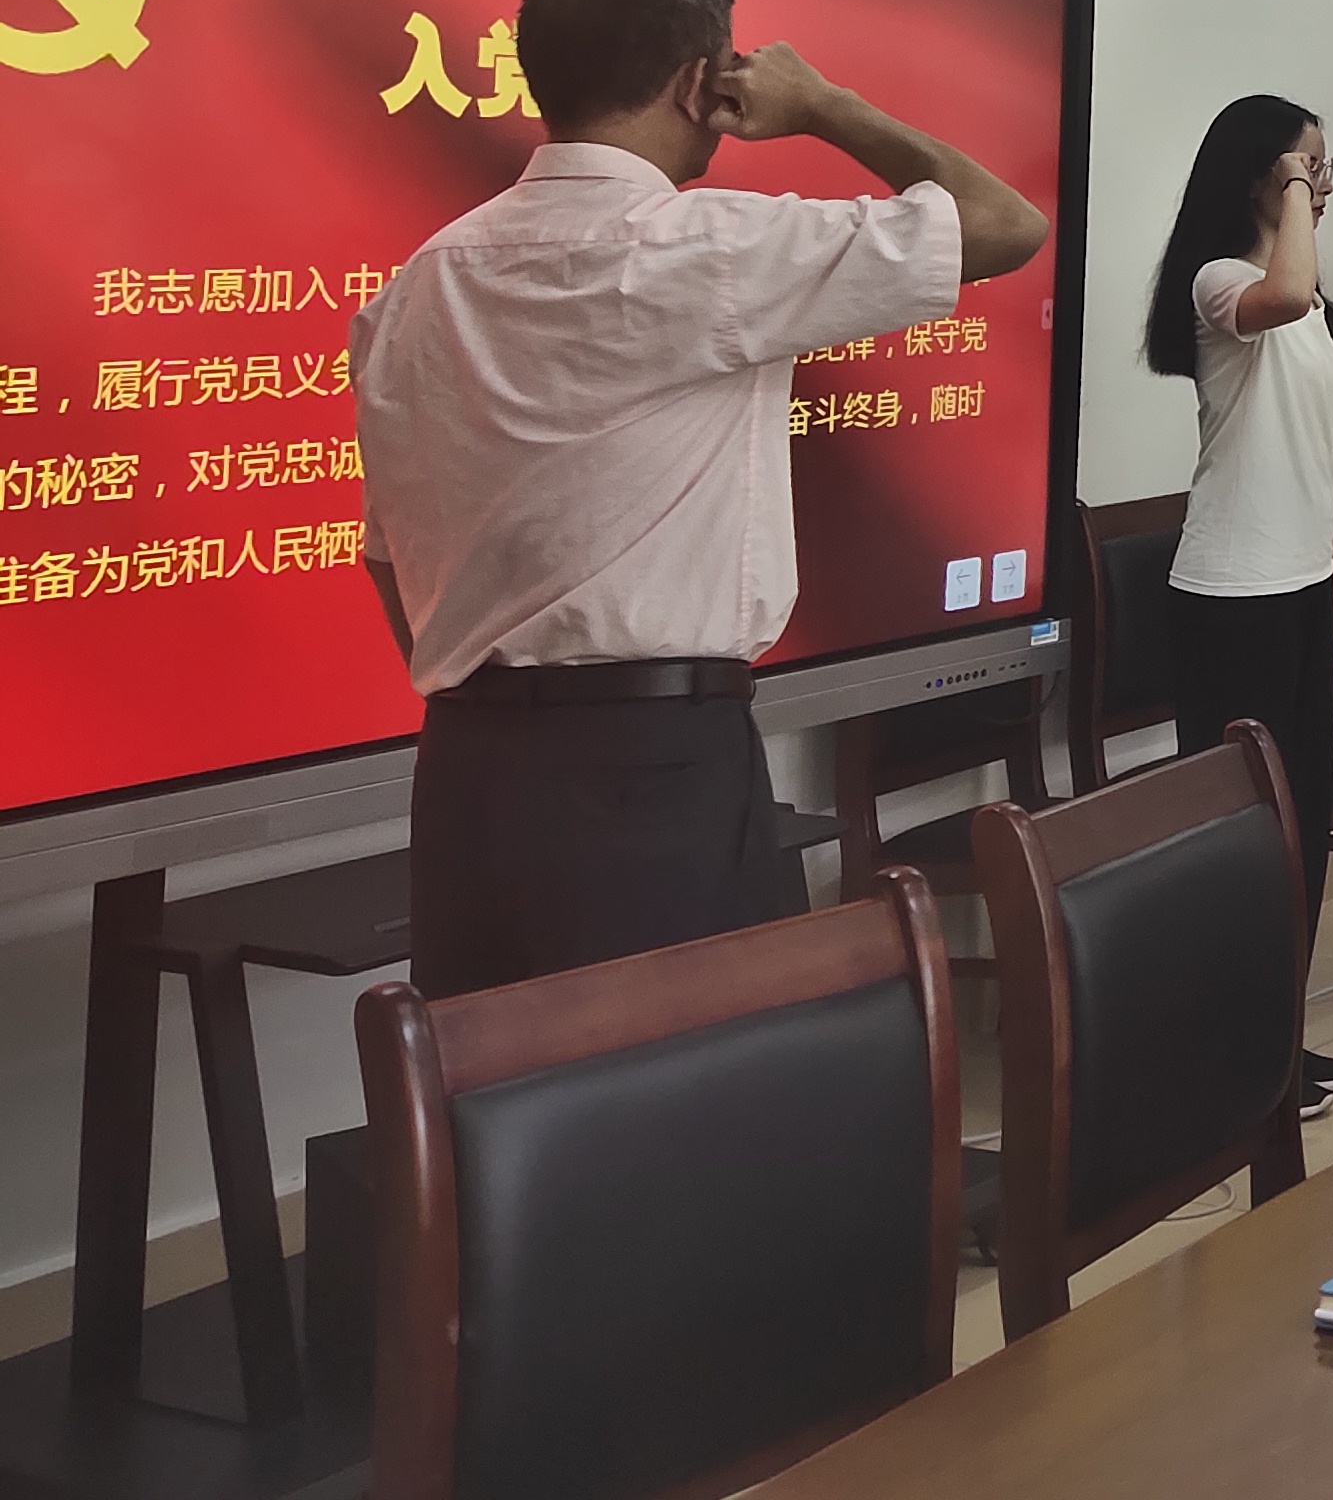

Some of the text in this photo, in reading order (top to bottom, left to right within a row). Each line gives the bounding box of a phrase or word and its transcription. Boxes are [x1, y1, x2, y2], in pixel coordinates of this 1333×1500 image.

[94, 263, 402, 316] 我志愿加入中
[0, 519, 365, 606] 准备为党和人民牺
